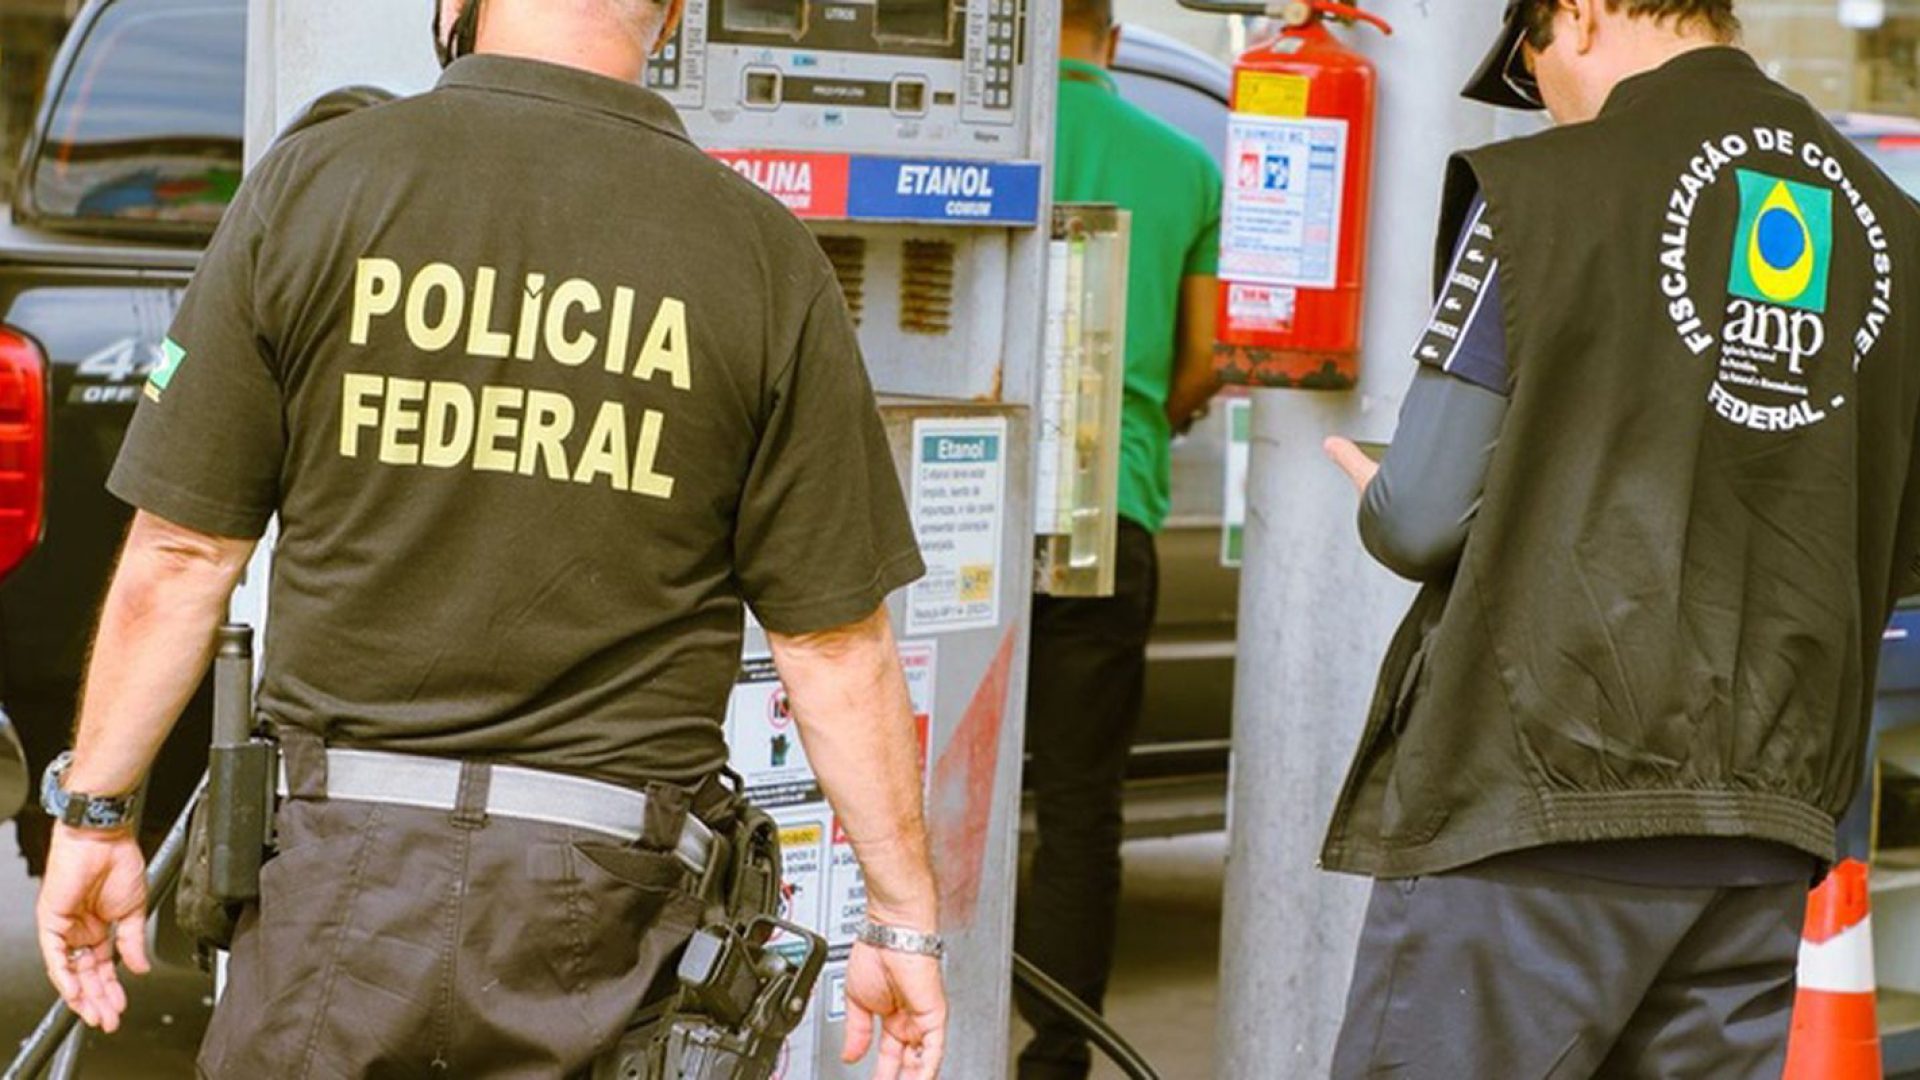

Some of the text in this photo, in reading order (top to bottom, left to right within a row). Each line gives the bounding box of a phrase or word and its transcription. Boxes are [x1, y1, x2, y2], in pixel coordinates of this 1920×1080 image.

[718, 157, 812, 193] OLINA
[896, 164, 994, 197] ETANOL
[1660, 133, 1749, 356] FISCALIZAÇÃO
[1753, 126, 1794, 155] DE
[1722, 299, 1825, 374] anp
[82, 385, 135, 402] OFF
[1707, 381, 1826, 431] FEDERAL
[339, 372, 676, 500] FEDERAL
[937, 438, 984, 460] Etanol
